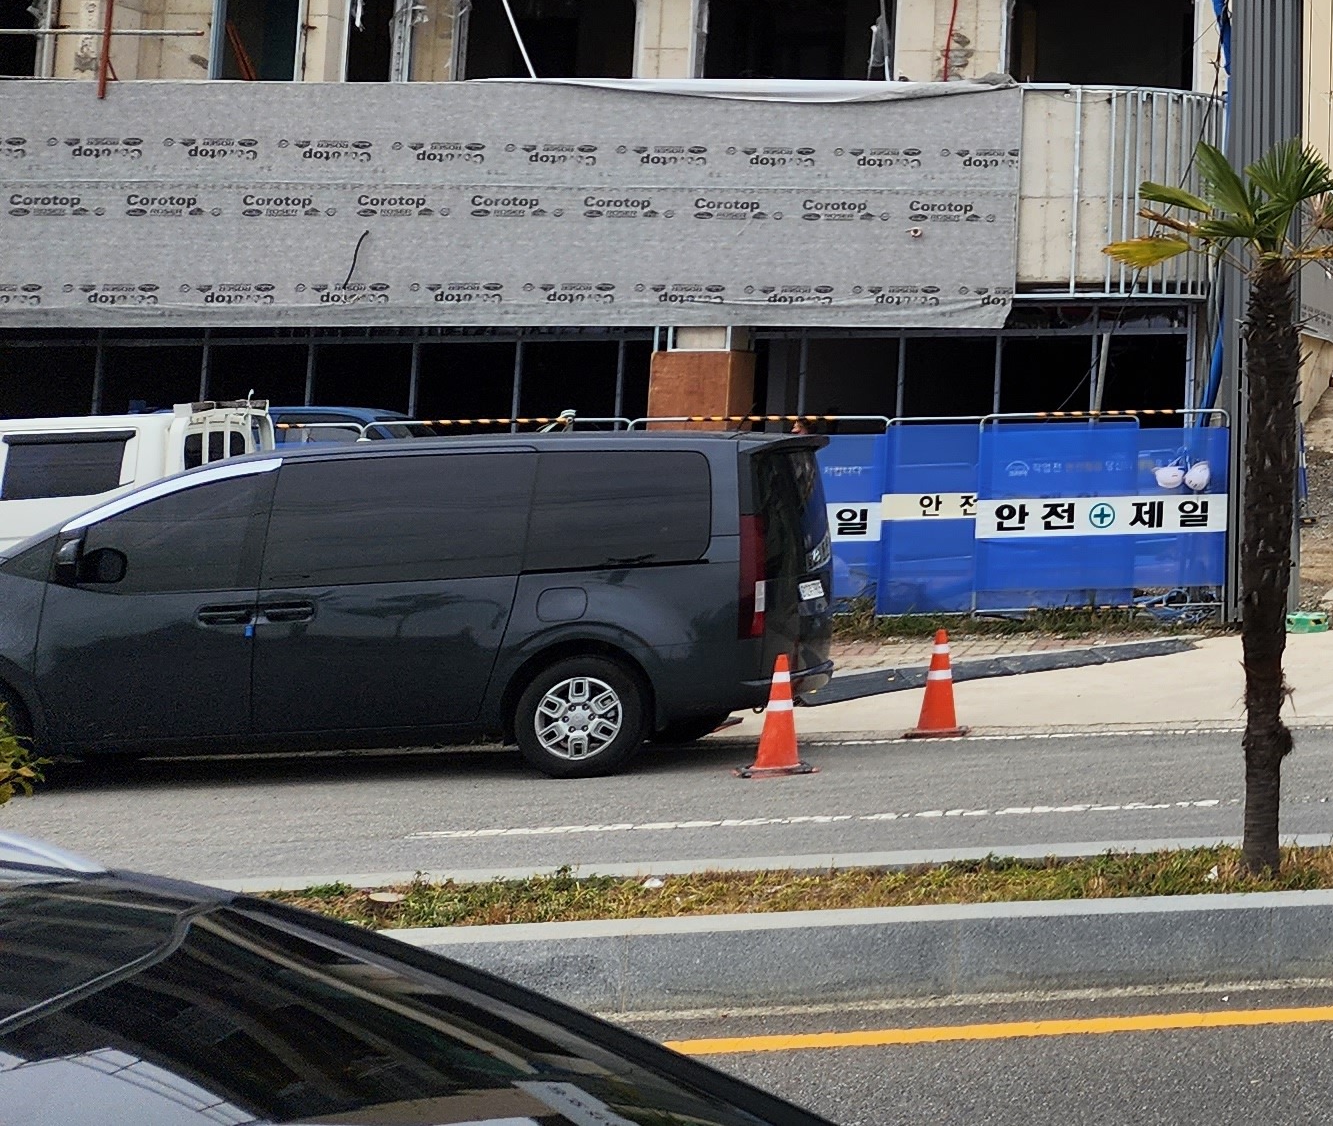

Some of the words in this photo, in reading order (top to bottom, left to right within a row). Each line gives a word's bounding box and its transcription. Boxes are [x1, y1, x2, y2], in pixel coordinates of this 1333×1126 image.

[9, 194, 81, 208] Corotop
[126, 194, 198, 208] Corotop
[242, 194, 313, 208] Corotop
[357, 194, 427, 208] Corotop
[471, 195, 540, 209] Corotop
[583, 196, 651, 210] Corotop
[694, 198, 760, 212] Corotop
[802, 199, 868, 213] Corotop
[909, 200, 974, 214] Corotop
[994, 502, 1076, 532] 안전
[1128, 499, 1210, 529] 제일
